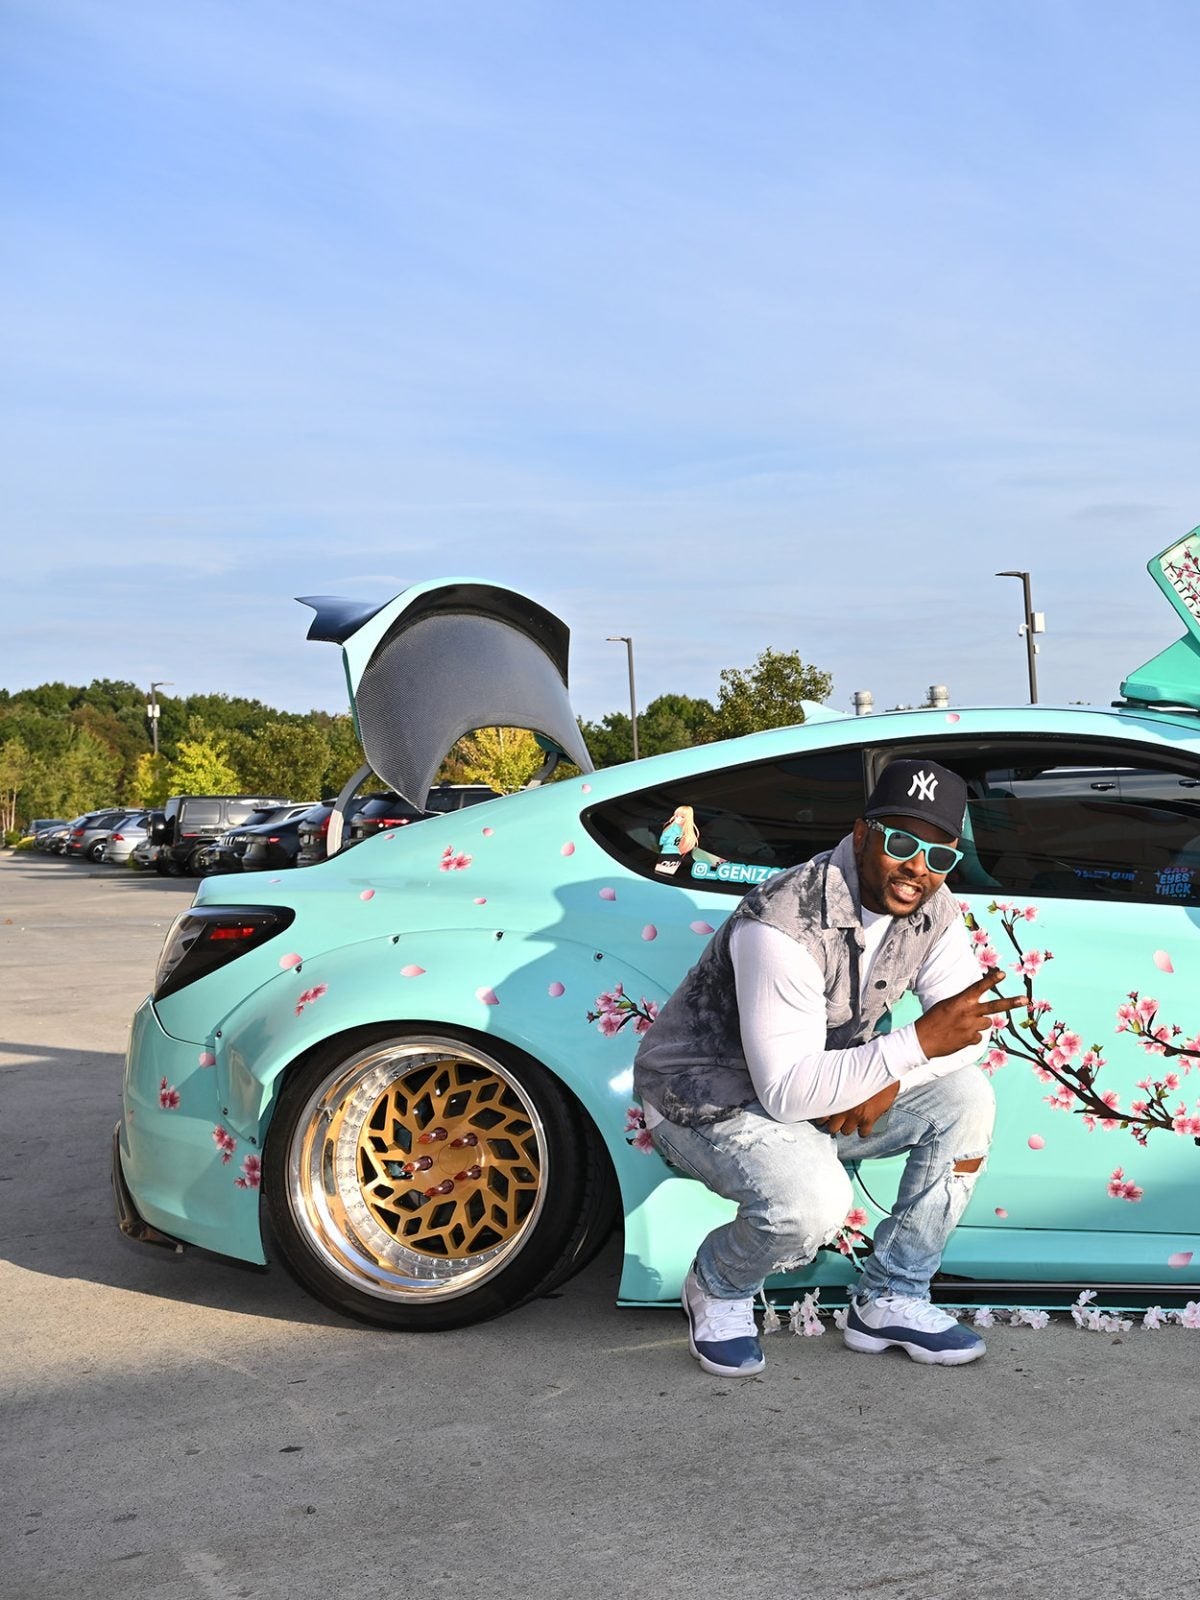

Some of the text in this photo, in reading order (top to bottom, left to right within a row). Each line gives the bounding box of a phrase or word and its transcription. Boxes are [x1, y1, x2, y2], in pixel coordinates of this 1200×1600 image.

[907, 770, 939, 802] NY
[1160, 873, 1190, 884] EYES
[1155, 882, 1192, 896] THICK
